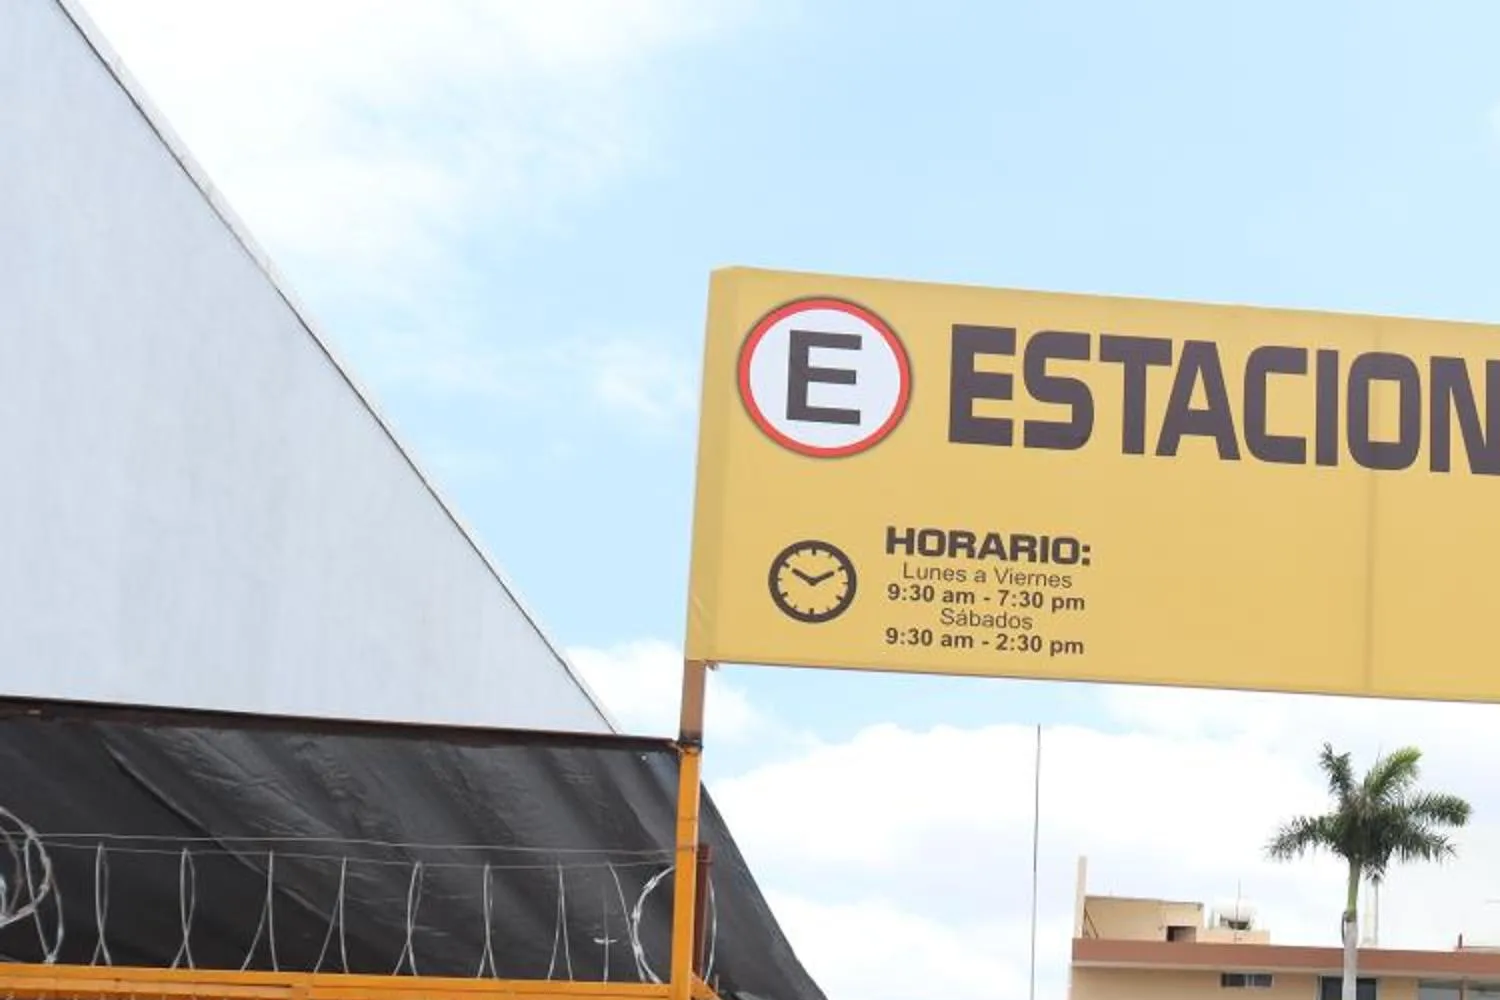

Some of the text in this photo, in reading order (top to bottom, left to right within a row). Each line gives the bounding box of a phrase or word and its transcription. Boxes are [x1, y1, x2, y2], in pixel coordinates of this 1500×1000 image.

[786, 330, 862, 425] E
[886, 526, 1091, 566] HORARIO:
[903, 562, 1073, 588] Lunes a Viernes
[887, 583, 935, 602] 9:30
[942, 590, 975, 605] am
[997, 589, 1044, 609] 7:30
[1051, 597, 1085, 613] pm
[940, 608, 1034, 630] Sábados
[885, 627, 933, 646] 9:30
[941, 634, 974, 649] am
[995, 633, 1042, 653] 2:30
[1050, 641, 1084, 657] pm
